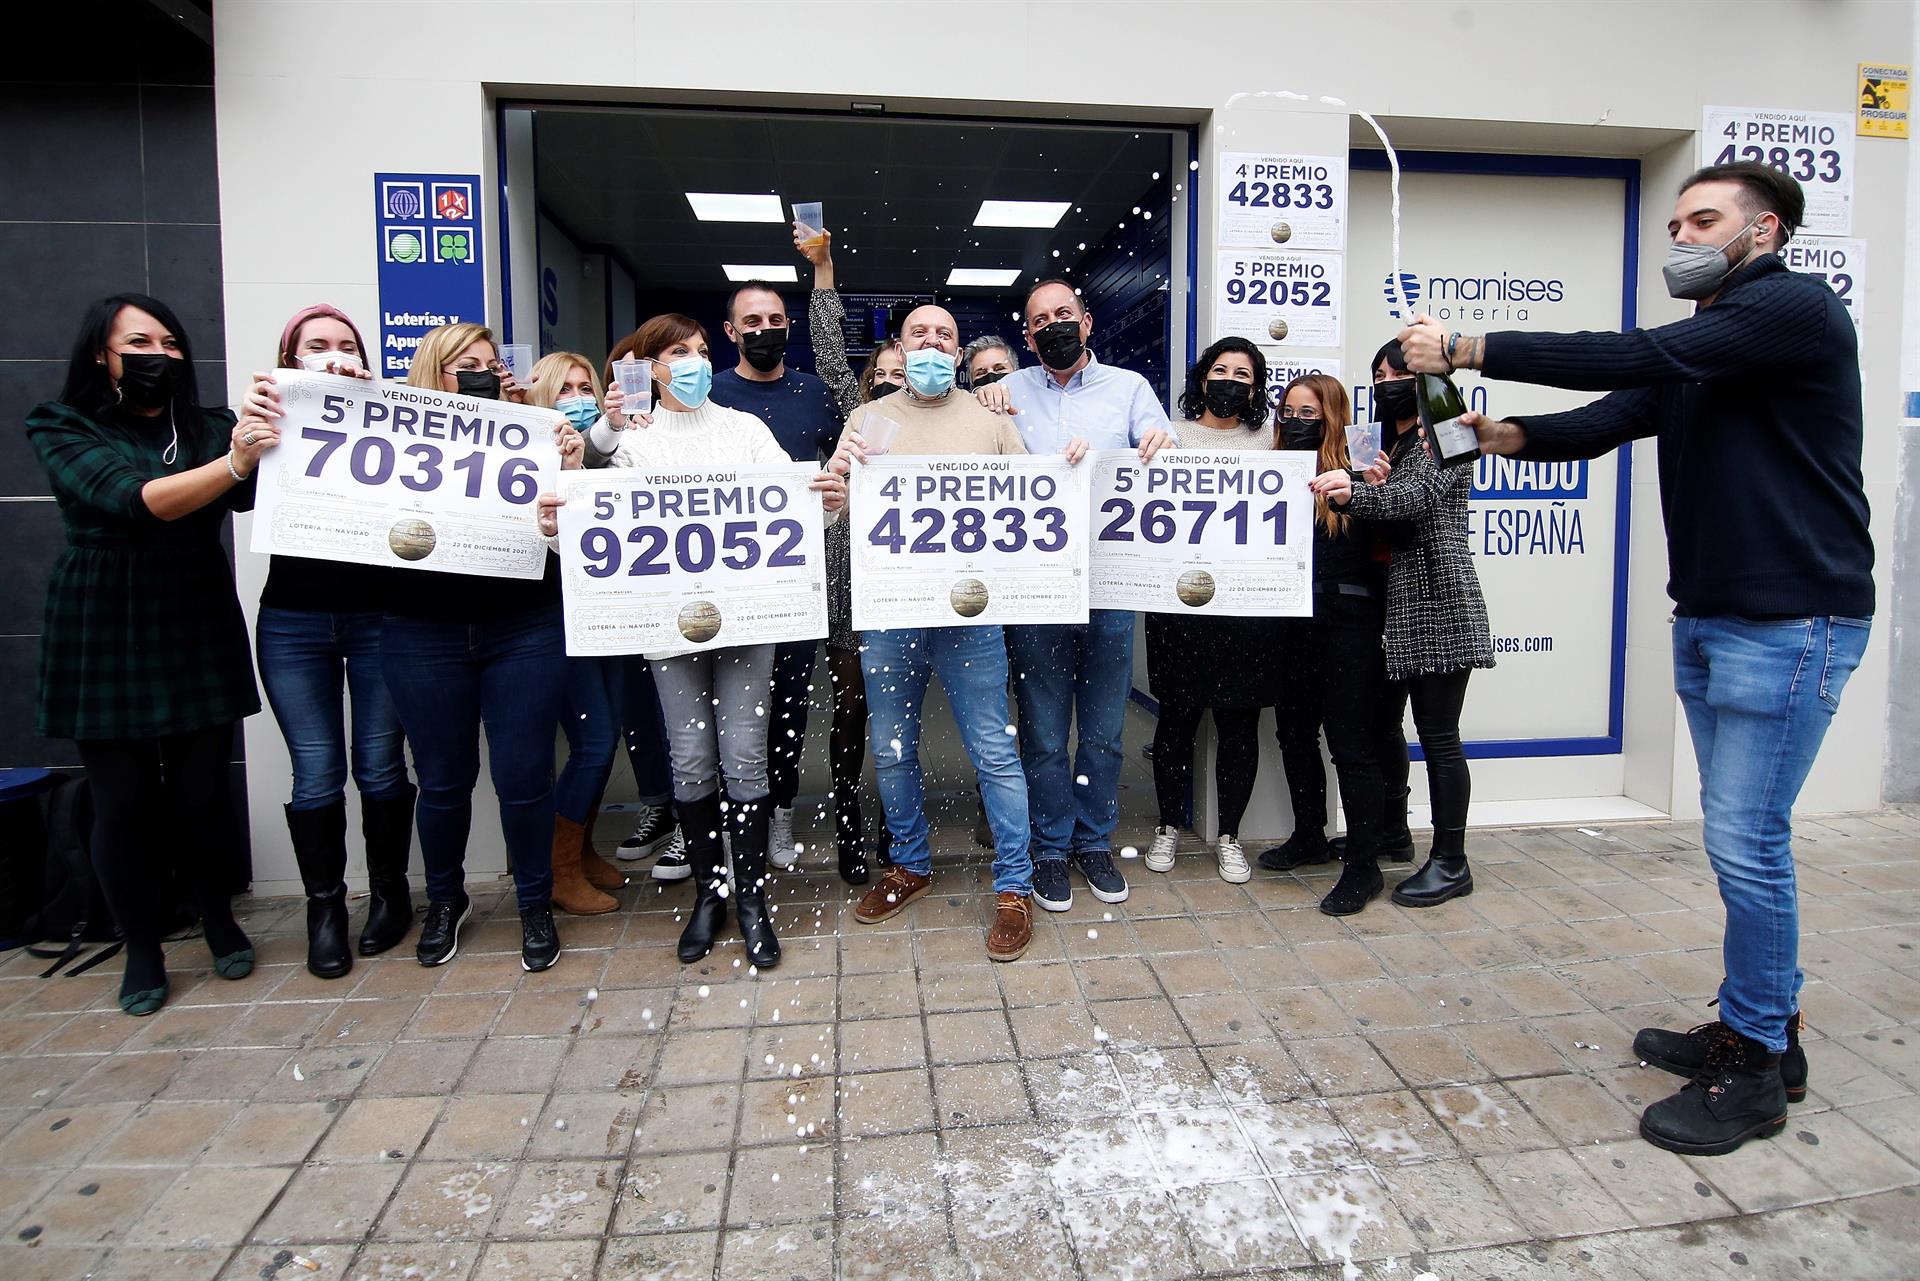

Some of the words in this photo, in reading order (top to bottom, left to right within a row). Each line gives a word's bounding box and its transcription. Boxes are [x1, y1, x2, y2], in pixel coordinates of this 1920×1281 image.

[1863, 68, 1907, 76] CONECTADA
[1755, 113, 1786, 121] VENDIDO
[1861, 110, 1907, 119] PROSEGUR
[1746, 122, 1834, 145] PREMIO
[1254, 164, 1327, 181] PREMIO
[1228, 182, 1333, 209] 42833
[1777, 248, 1846, 269] REMIO
[1252, 262, 1324, 279] PREMIO
[1226, 279, 1330, 306] 92052
[1429, 272, 1564, 302] manises
[385, 312, 446, 326] Loterías
[1428, 304, 1528, 320] lotería
[382, 389, 442, 407] VENDIDO
[447, 401, 480, 413] AQUÍ
[321, 395, 354, 424] 5º
[363, 400, 530, 450] PREMIO
[301, 427, 540, 505] 70316
[928, 462, 979, 472] VENDIDO
[982, 460, 1010, 472] AQUÍ
[1162, 455, 1210, 465] VENDIDO
[1214, 455, 1240, 465] AQUÍ
[645, 474, 702, 485] VENDIDO
[706, 470, 737, 483] AQUÍ
[1114, 468, 1140, 493] 5º
[1148, 468, 1283, 495] PREMIO
[880, 476, 907, 502] 4º
[916, 475, 1056, 501] PREMIO
[594, 492, 621, 521] 5º
[631, 485, 788, 519] PREMIO
[289, 522, 322, 531] LOTERÍA
[335, 528, 370, 537] NAVIDAD
[868, 507, 1068, 554] 42833
[1098, 498, 1288, 545] 26711
[1484, 501, 1584, 556] ESPAÑA
[474, 545, 511, 553] DICIEMBRE
[580, 519, 806, 578] 92052
[588, 623, 616, 631] LOTERÍA
[1492, 635, 1553, 653] ises.com
